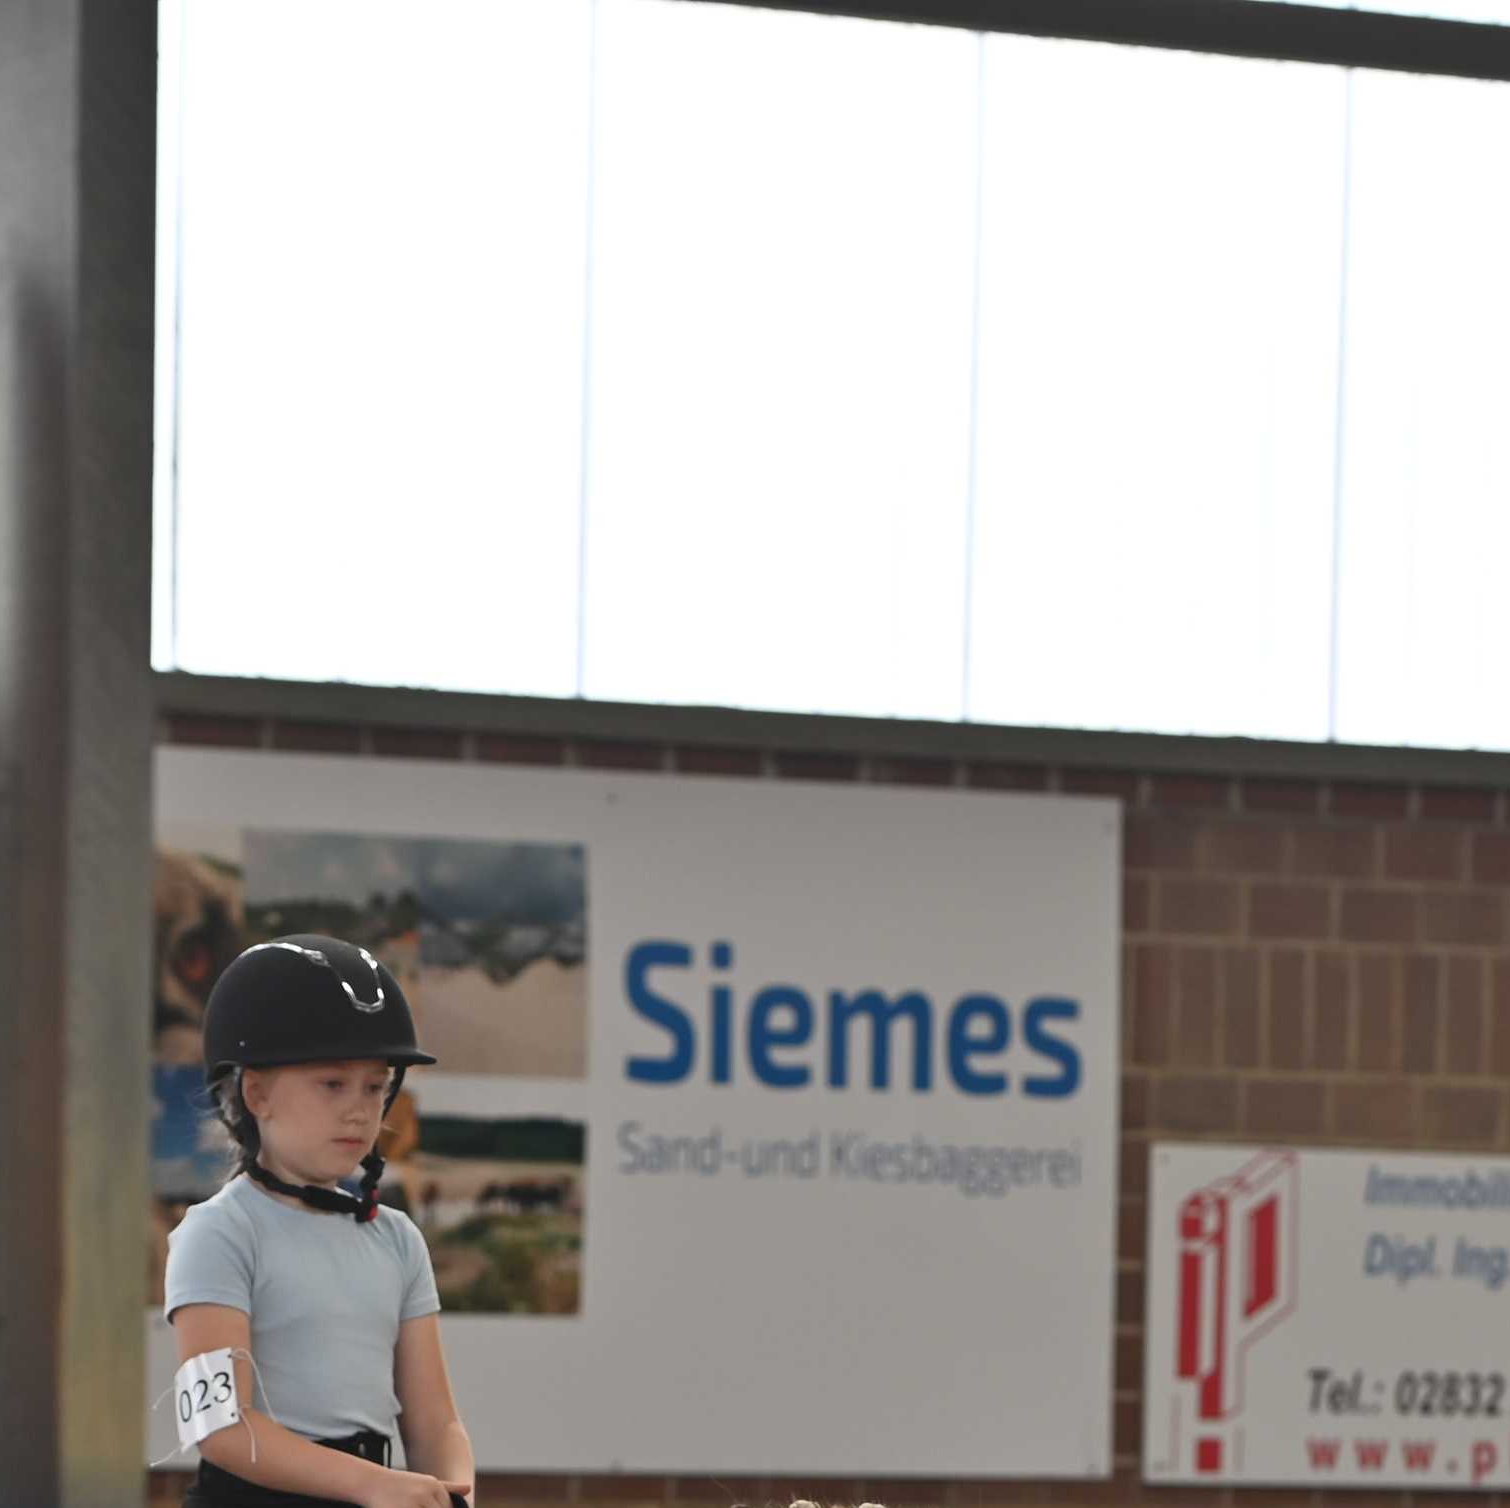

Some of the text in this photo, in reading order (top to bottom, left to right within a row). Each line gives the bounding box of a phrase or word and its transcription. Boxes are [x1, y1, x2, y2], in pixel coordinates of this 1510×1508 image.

[623, 939, 1083, 1099] Siemes
[829, 1130, 1085, 1199] Kiesbaggerei
[1363, 1233, 1443, 1288] Dipl.
[179, 1371, 232, 1422] 023
[1394, 1369, 1506, 1418] 02832
